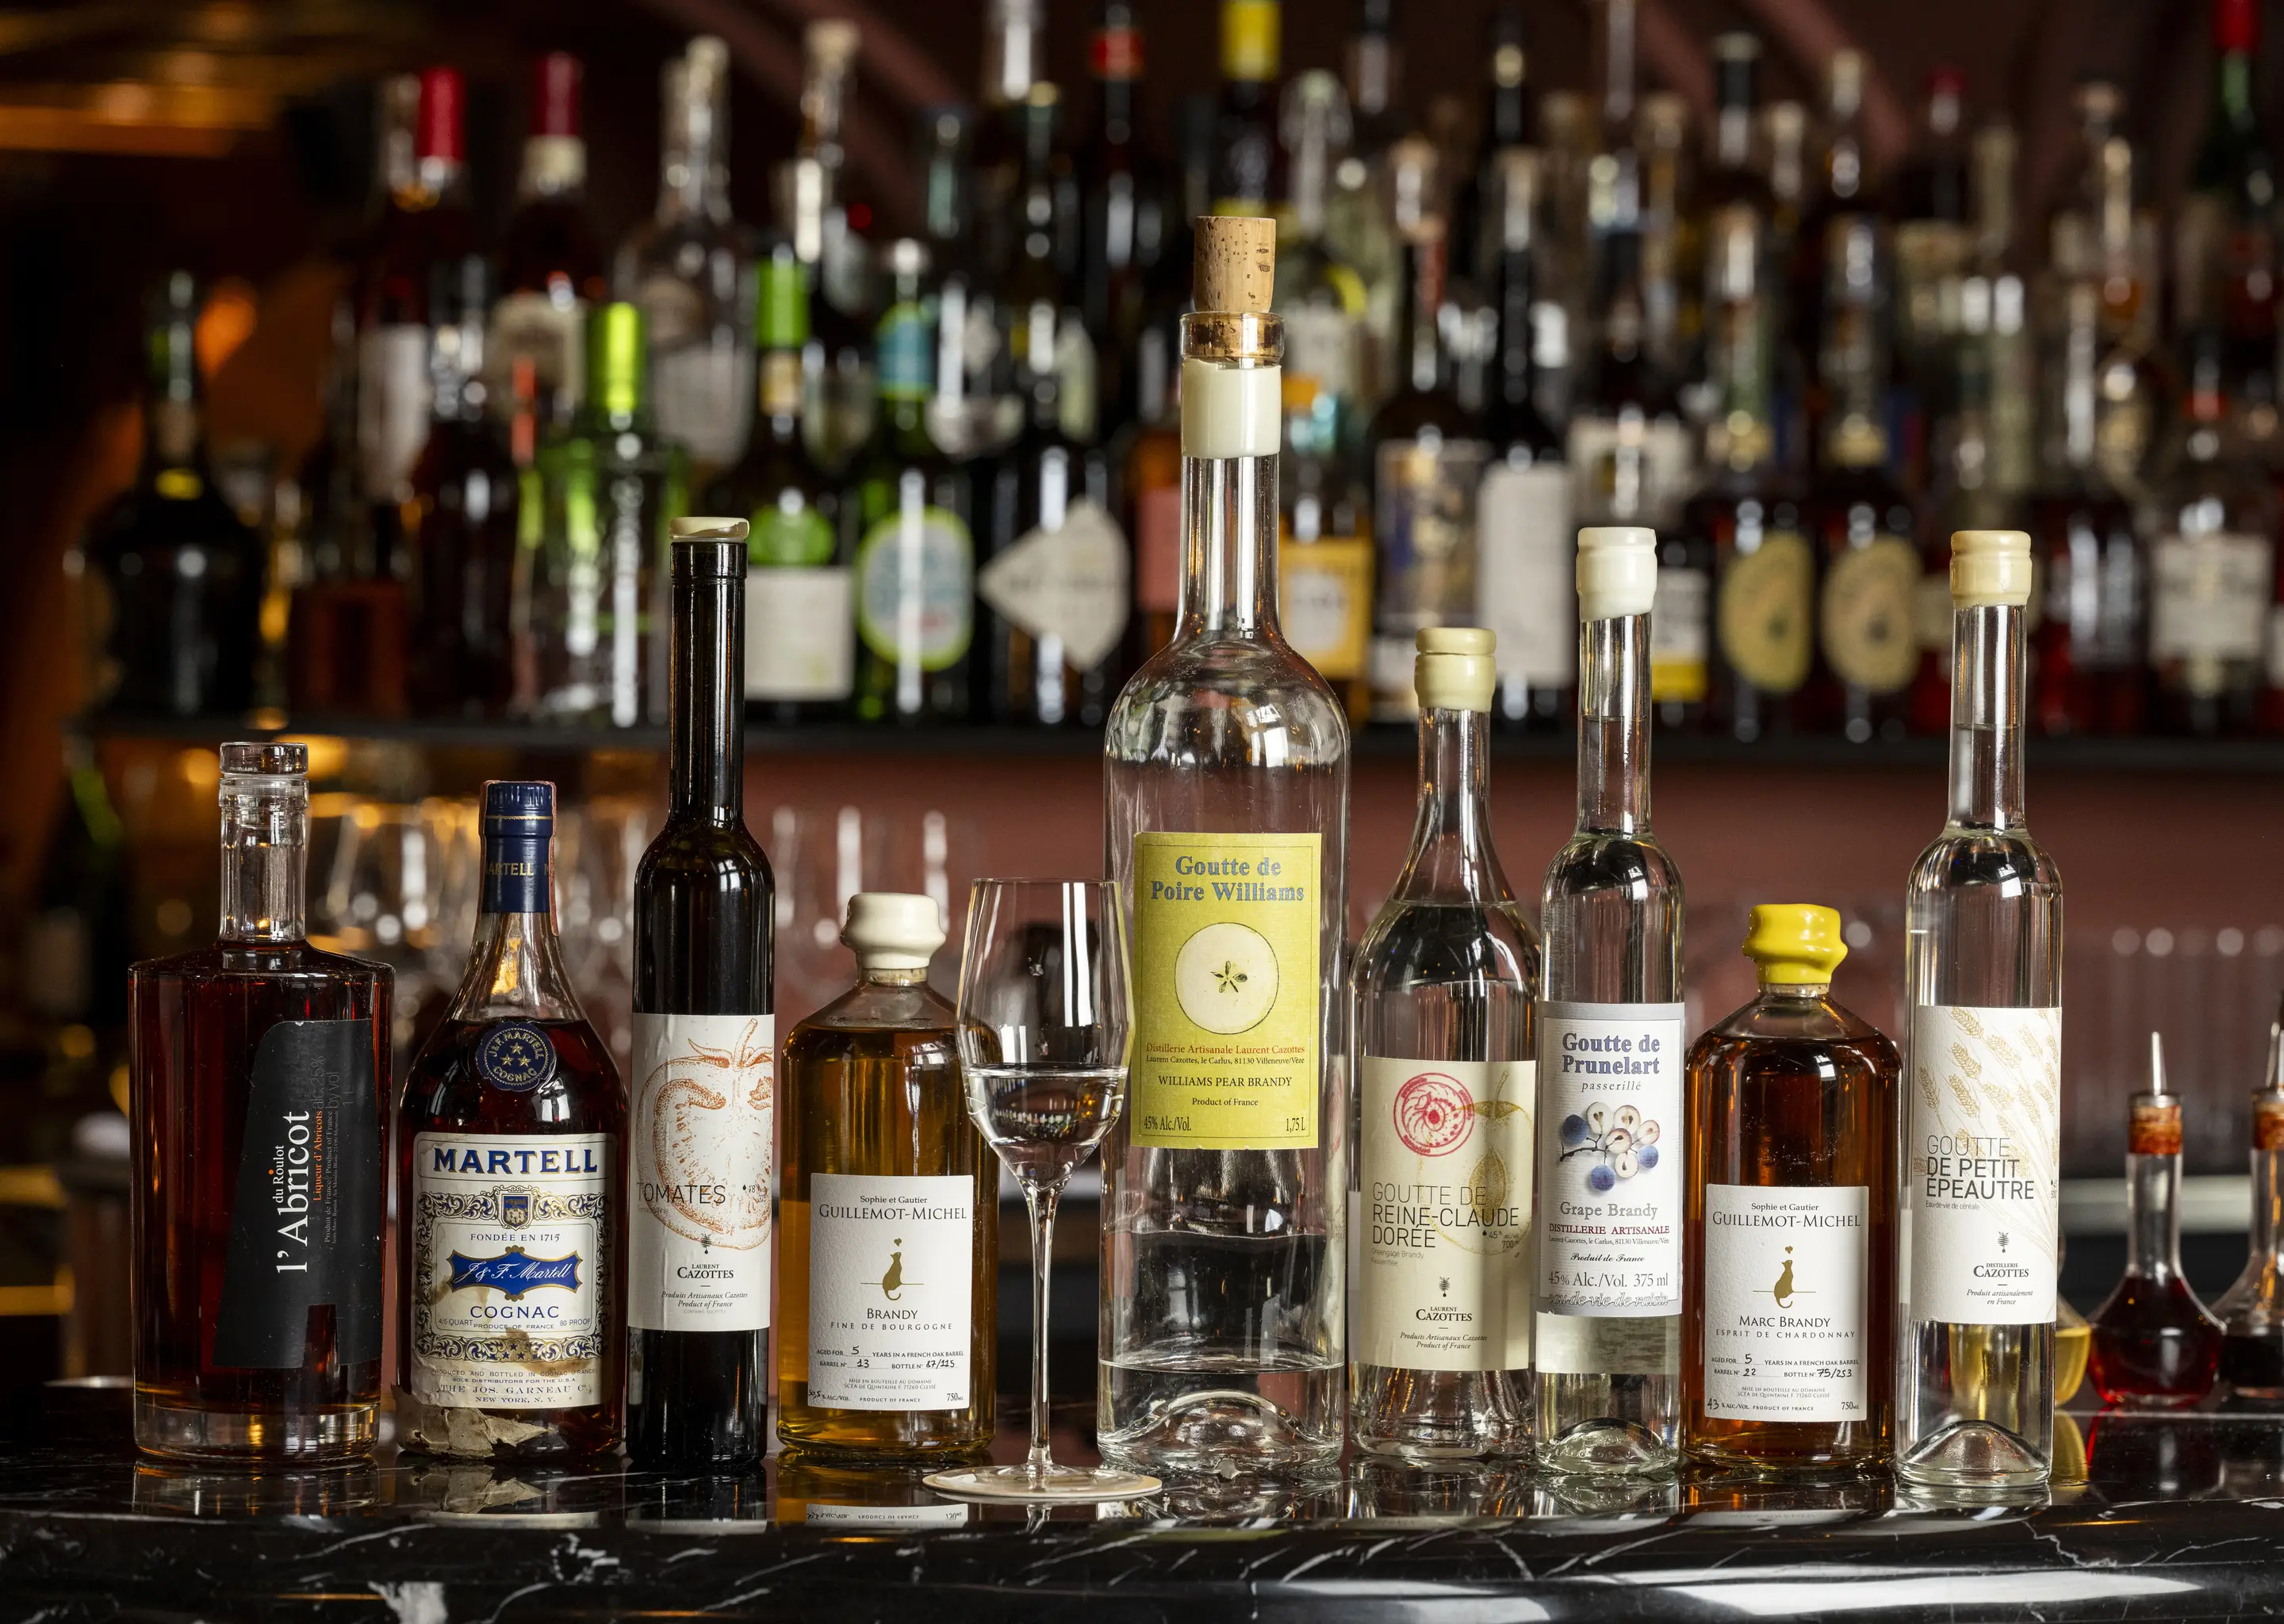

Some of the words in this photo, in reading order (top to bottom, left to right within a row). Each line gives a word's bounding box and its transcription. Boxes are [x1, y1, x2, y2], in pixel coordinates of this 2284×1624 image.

[486, 863, 534, 876] ARTELL
[1175, 856, 1250, 875] Goutte
[1257, 856, 1282, 876] de
[1151, 880, 1204, 901] Poire
[1212, 882, 1304, 902] Williams
[1146, 1043, 1186, 1053] Distillerie
[1187, 1044, 1232, 1054] Artisanale
[1236, 1045, 1270, 1054] Laurent
[1271, 1045, 1305, 1054] Cazottes
[1562, 1032, 1632, 1052] Goutte
[1638, 1034, 1660, 1052] de
[1170, 1056, 1200, 1065] Cazottes,
[1562, 1055, 1660, 1074] Prunelart
[493, 1067, 537, 1082] COGNAC
[1158, 1076, 1213, 1086] WILLIAMS
[1216, 1077, 1244, 1086] PEAR
[1248, 1077, 1292, 1087] BRANDY
[1581, 1081, 1642, 1092] passerillé
[1144, 1116, 1158, 1130] 45%
[1159, 1116, 1191, 1131] Alc./Vol.
[1286, 1118, 1300, 1133] 1,75
[1301, 1117, 1305, 1131] L
[313, 1110, 323, 1162] d'Abricots
[1927, 1135, 2010, 1156] GOUTTE
[273, 1145, 285, 1185] Roulot
[433, 1147, 597, 1174] MARTELL
[1927, 1156, 1951, 1176] DE
[1959, 1158, 2020, 1178] PETIT
[313, 1164, 324, 1201] Liqueur
[1926, 1174, 2034, 1200] ÉPEAUTRE
[273, 1189, 284, 1203] du
[636, 1182, 726, 1205] TOMATES
[860, 1196, 887, 1205] Sophie
[1373, 1182, 1451, 1205] GOUTTE
[1460, 1186, 1486, 1205] DE
[819, 1204, 967, 1220] GUILLEMOT-MICHEL
[1560, 1201, 1602, 1220] Grape
[1608, 1203, 1657, 1220] Brandy
[1751, 1203, 1778, 1212] Sophie
[1960, 1201, 1979, 1210] céréale
[1374, 1204, 1519, 1227] REINE-CLAUDE
[1712, 1211, 1861, 1227] GUILLEMOT-MICHEL
[1373, 1224, 1436, 1247] DORÉE
[1549, 1223, 1606, 1235] DISTILLERIE
[1611, 1225, 1669, 1235] ARTISANALE
[470, 1232, 515, 1241] FONDÉE
[1570, 1253, 1604, 1262] Produit
[1615, 1254, 1645, 1262] France
[476, 1266, 491, 1282] &
[509, 1262, 573, 1281] Martell
[676, 1266, 734, 1279] CAZOTTES
[1973, 1265, 2029, 1277] CAZOTTES
[1548, 1271, 1569, 1285] 45%
[1573, 1272, 1627, 1287] Alc./Vol.
[1634, 1274, 1654, 1287] 375
[1657, 1273, 1669, 1285] ml
[704, 1300, 711, 1309] of
[470, 1306, 559, 1319] COGNAC
[867, 1308, 918, 1320] BRANDY
[1416, 1308, 1473, 1322] CAZOTTES
[1739, 1316, 1776, 1327] MARC
[1780, 1316, 1830, 1327] BRANDY
[851, 1346, 860, 1355] 5
[856, 1358, 870, 1368] 13
[1745, 1354, 1753, 1364] 5
[1742, 1368, 1757, 1377] 22
[1707, 1398, 1719, 1410] 43
